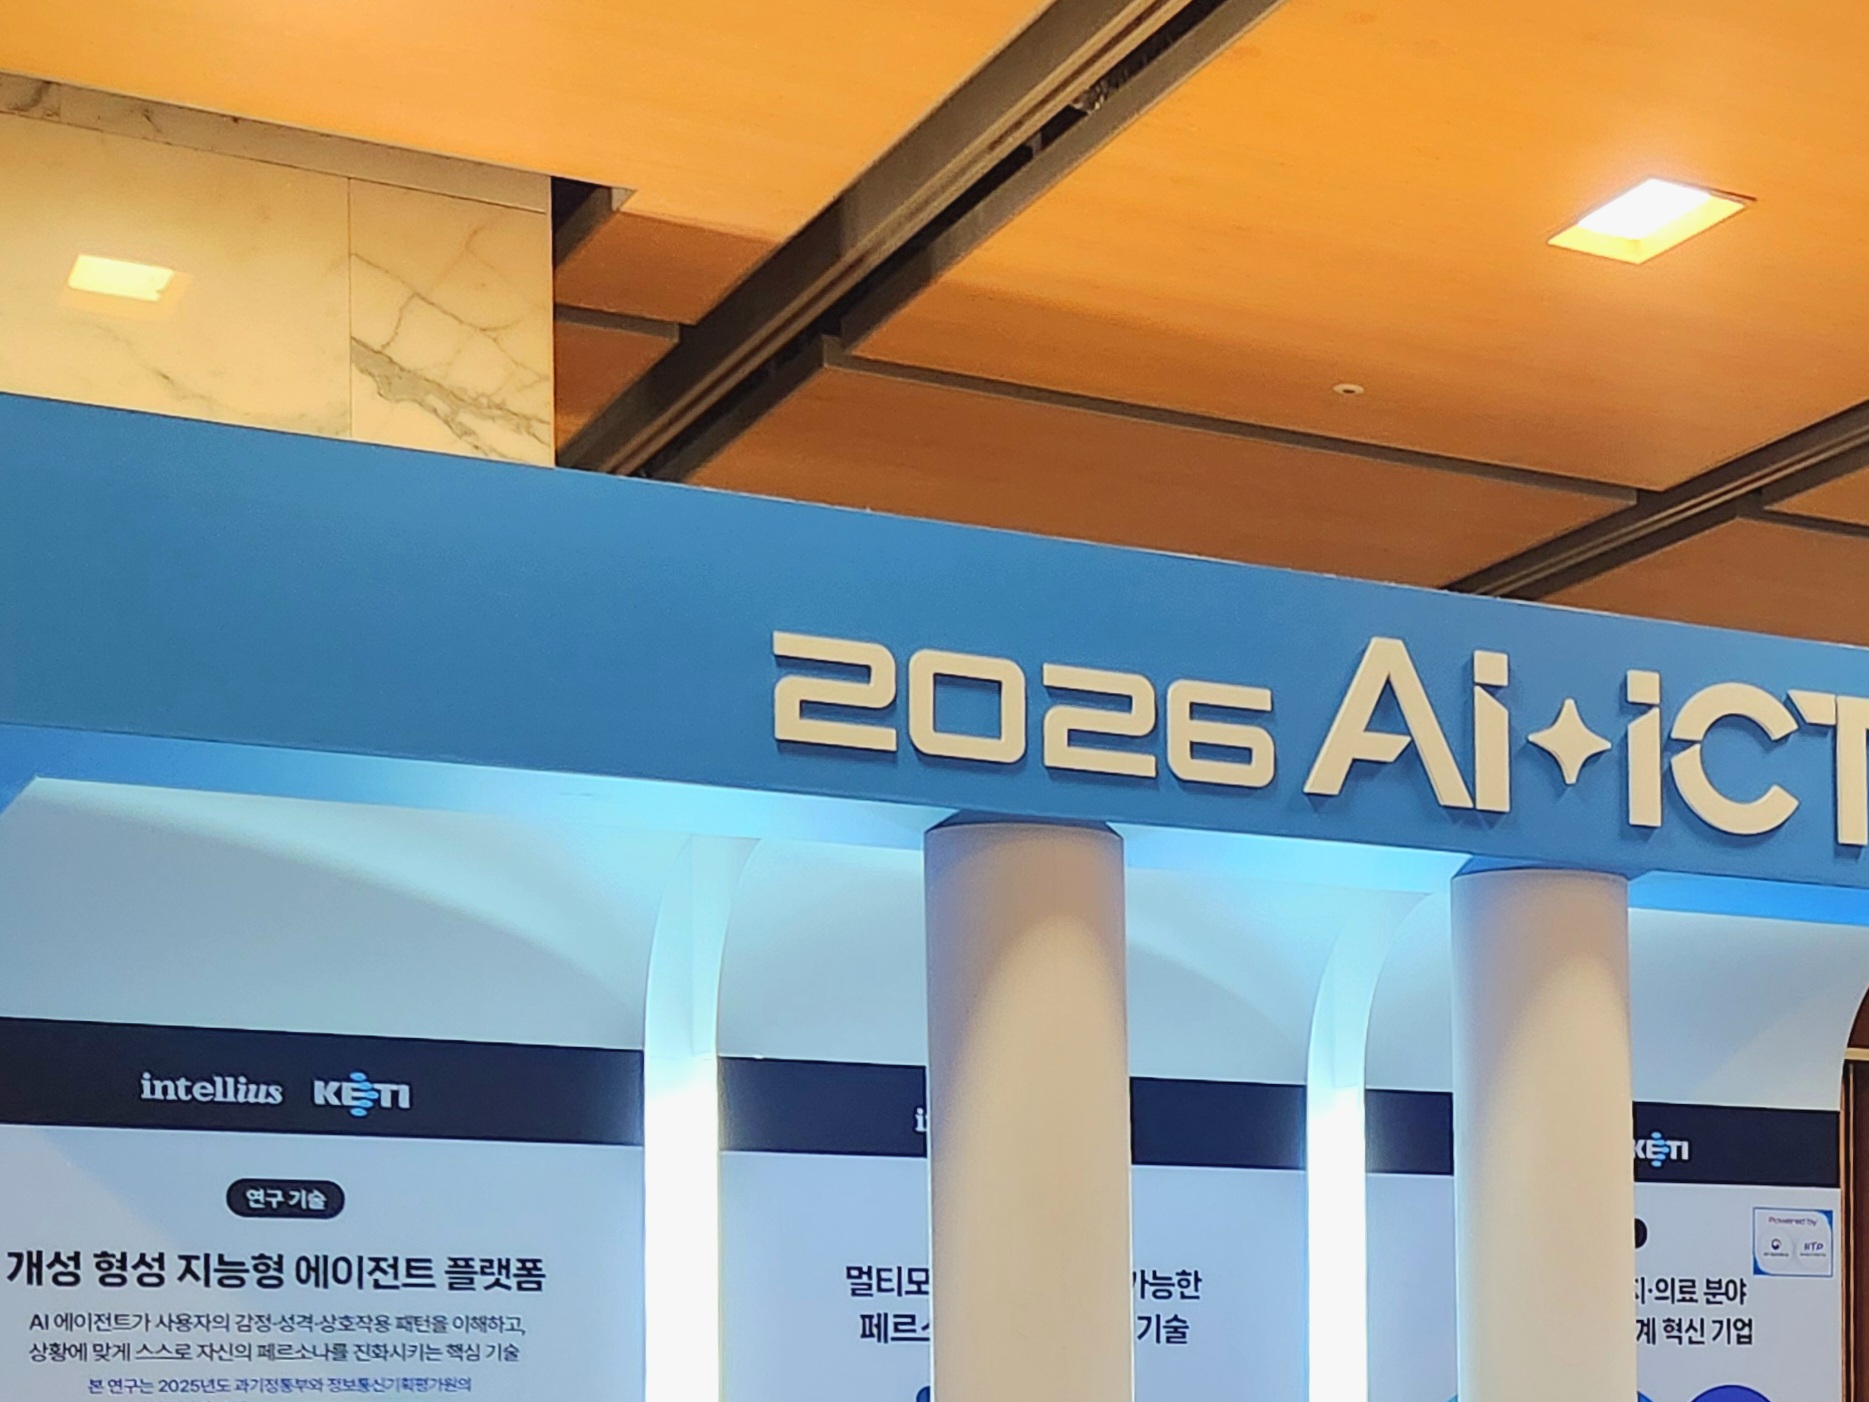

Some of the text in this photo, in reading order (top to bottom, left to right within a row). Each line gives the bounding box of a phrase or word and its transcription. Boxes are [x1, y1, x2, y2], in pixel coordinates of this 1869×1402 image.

[772, 630, 1276, 789] 2026
[140, 1071, 412, 1117] intellius KETI
[1634, 1132, 1690, 1167] KETI
[246, 1188, 328, 1211] 연구 기술
[6, 1250, 547, 1292] 개성 형성 지능형 에이전트 플랫폼
[1703, 1277, 1747, 1305] 분야
[28, 1312, 50, 1331] AI
[53, 1312, 151, 1333] 에이전트가
[155, 1312, 231, 1333] 사용자의
[395, 1314, 449, 1334] 패턴을
[452, 1314, 527, 1336] 이해하고,
[1136, 1313, 1191, 1345] 기술
[1662, 1317, 1705, 1346] 혁신
[1711, 1317, 1753, 1346] 기업
[29, 1341, 521, 1362] 상황에 맞게 스스로 자신의 페르소나를 진화시키는 핵심 기술
[87, 1378, 104, 1394] 본
[107, 1378, 154, 1395] 연구는
[157, 1378, 232, 1395] 2025년도
